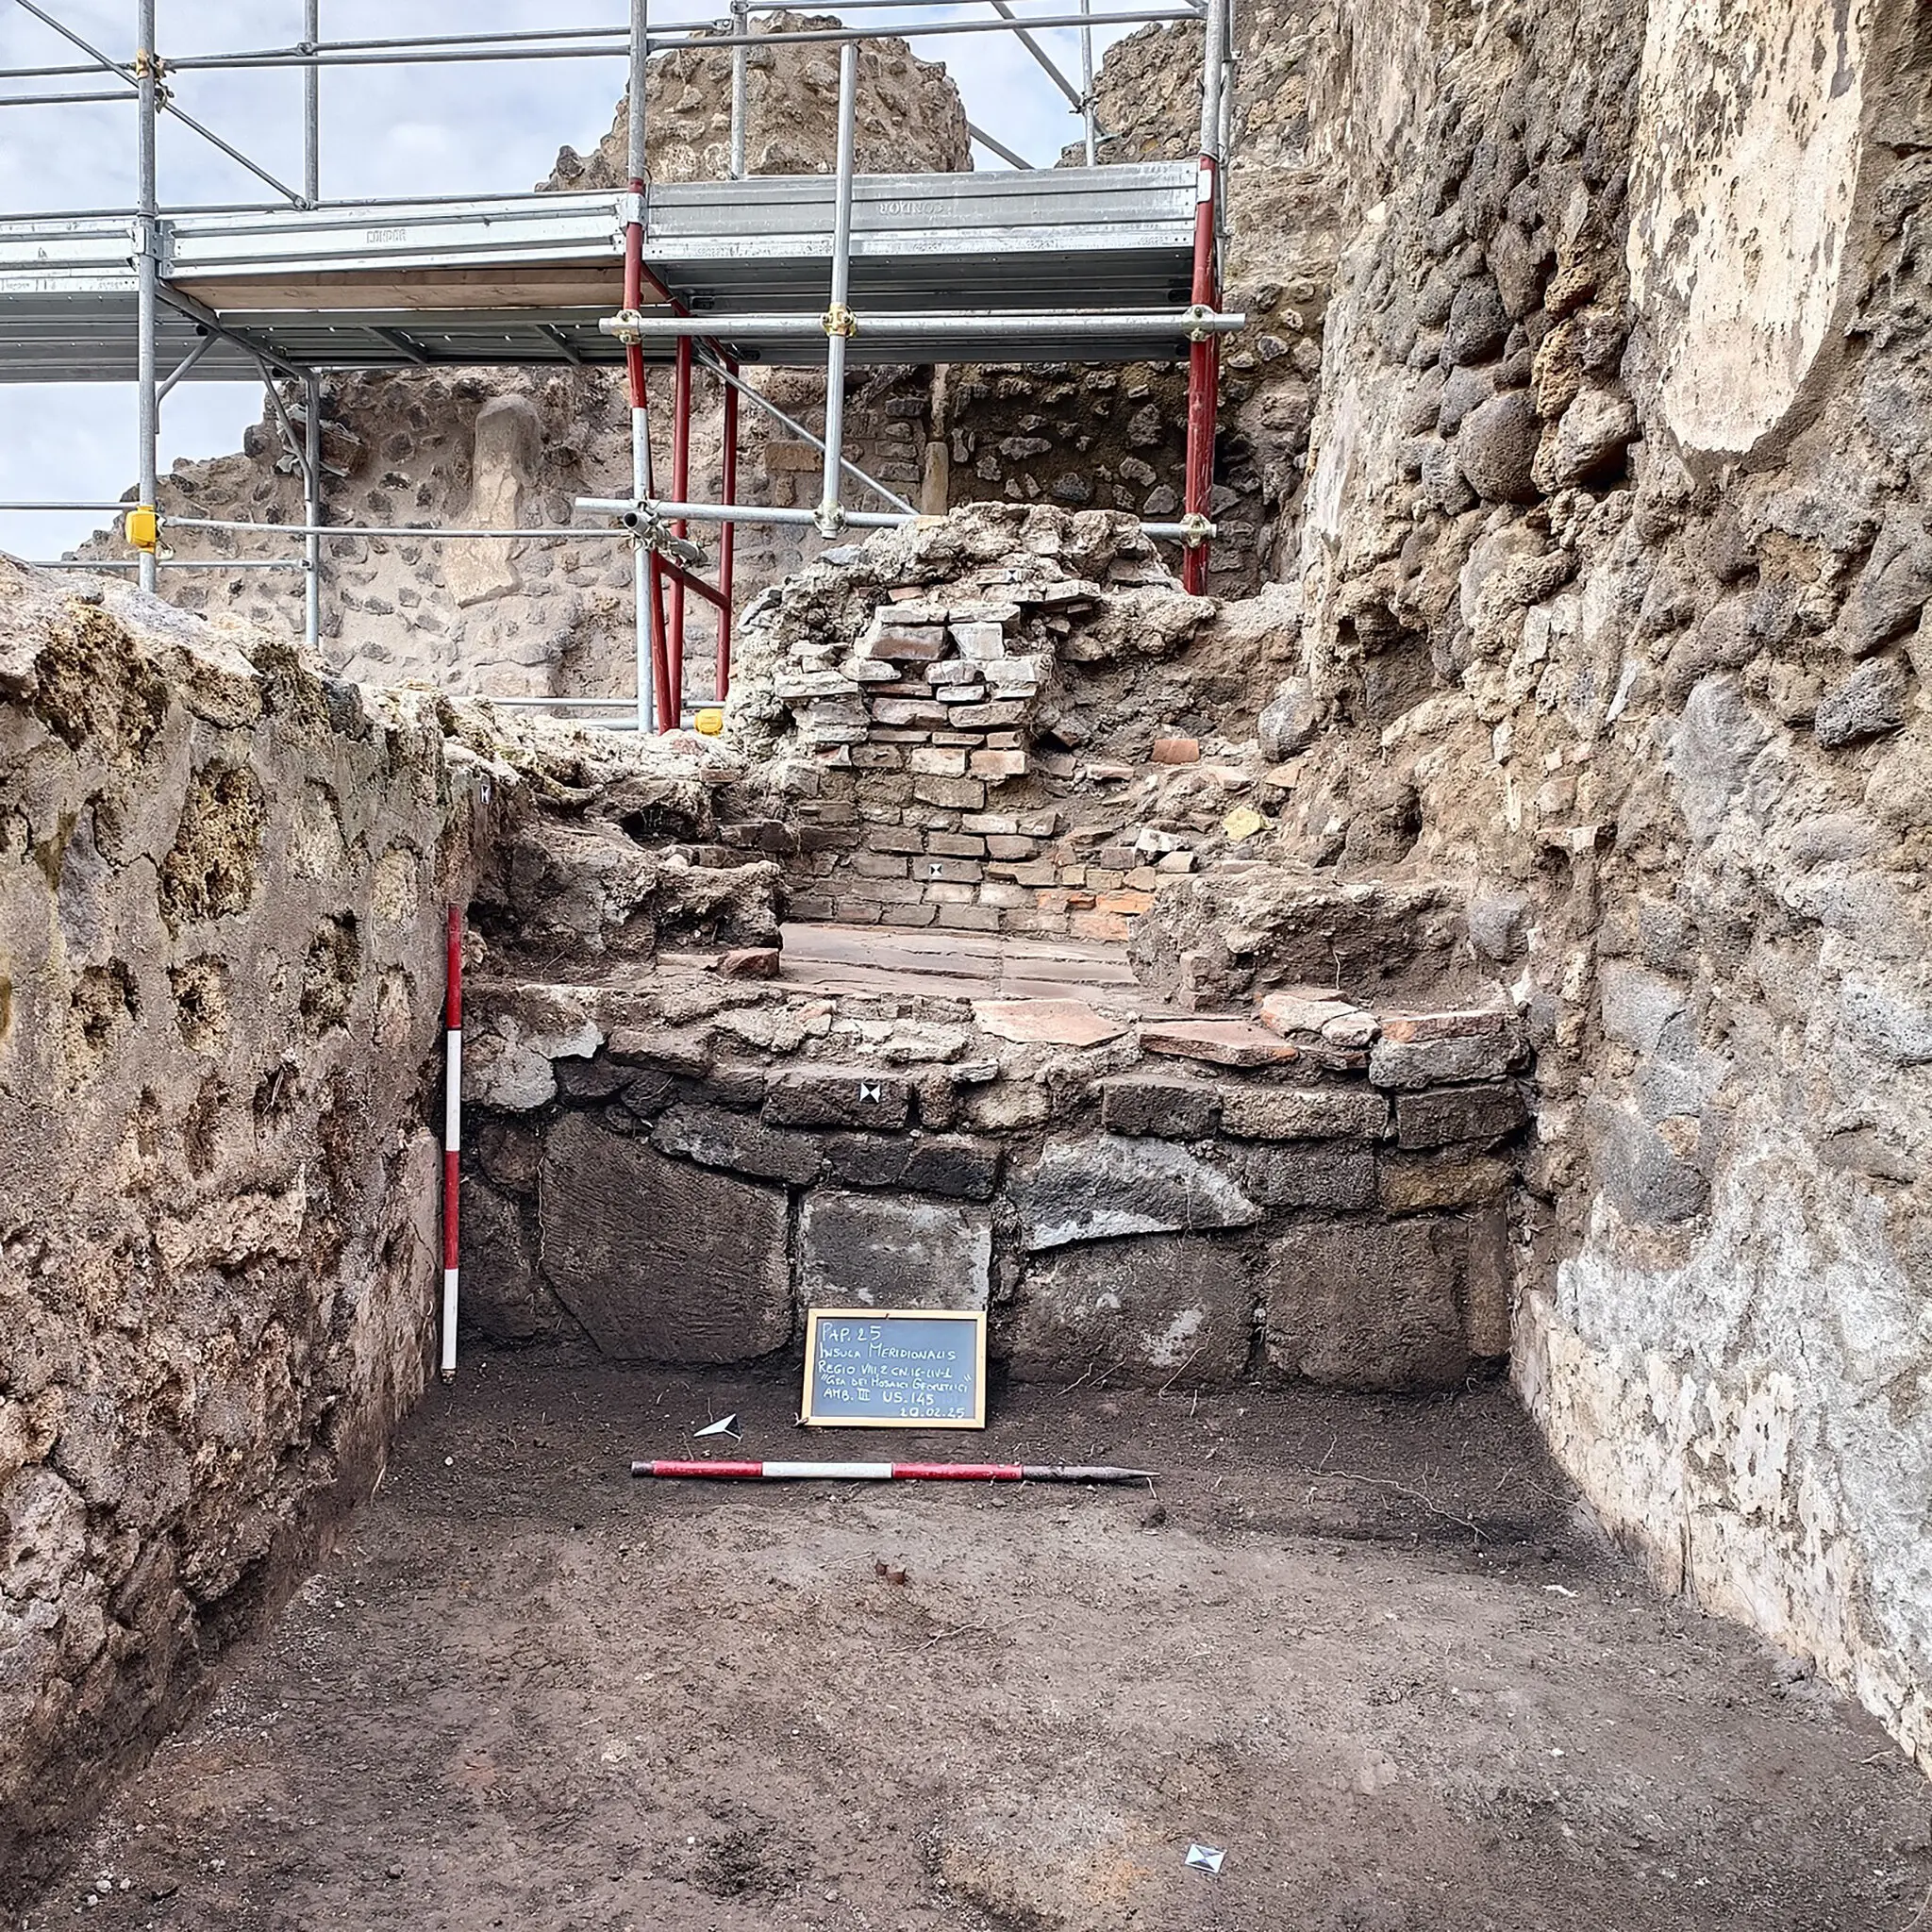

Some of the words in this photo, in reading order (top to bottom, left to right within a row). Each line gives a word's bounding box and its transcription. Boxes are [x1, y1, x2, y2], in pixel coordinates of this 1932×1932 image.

[822, 1322, 851, 1342] PAP.
[858, 1325, 882, 1341] 25
[868, 1342, 957, 1360] MERIDIONALIS
[818, 1359, 856, 1374] REGIO
[851, 1377, 868, 1387] DEI
[823, 1388, 855, 1402] AMB.
[857, 1387, 871, 1401] III
